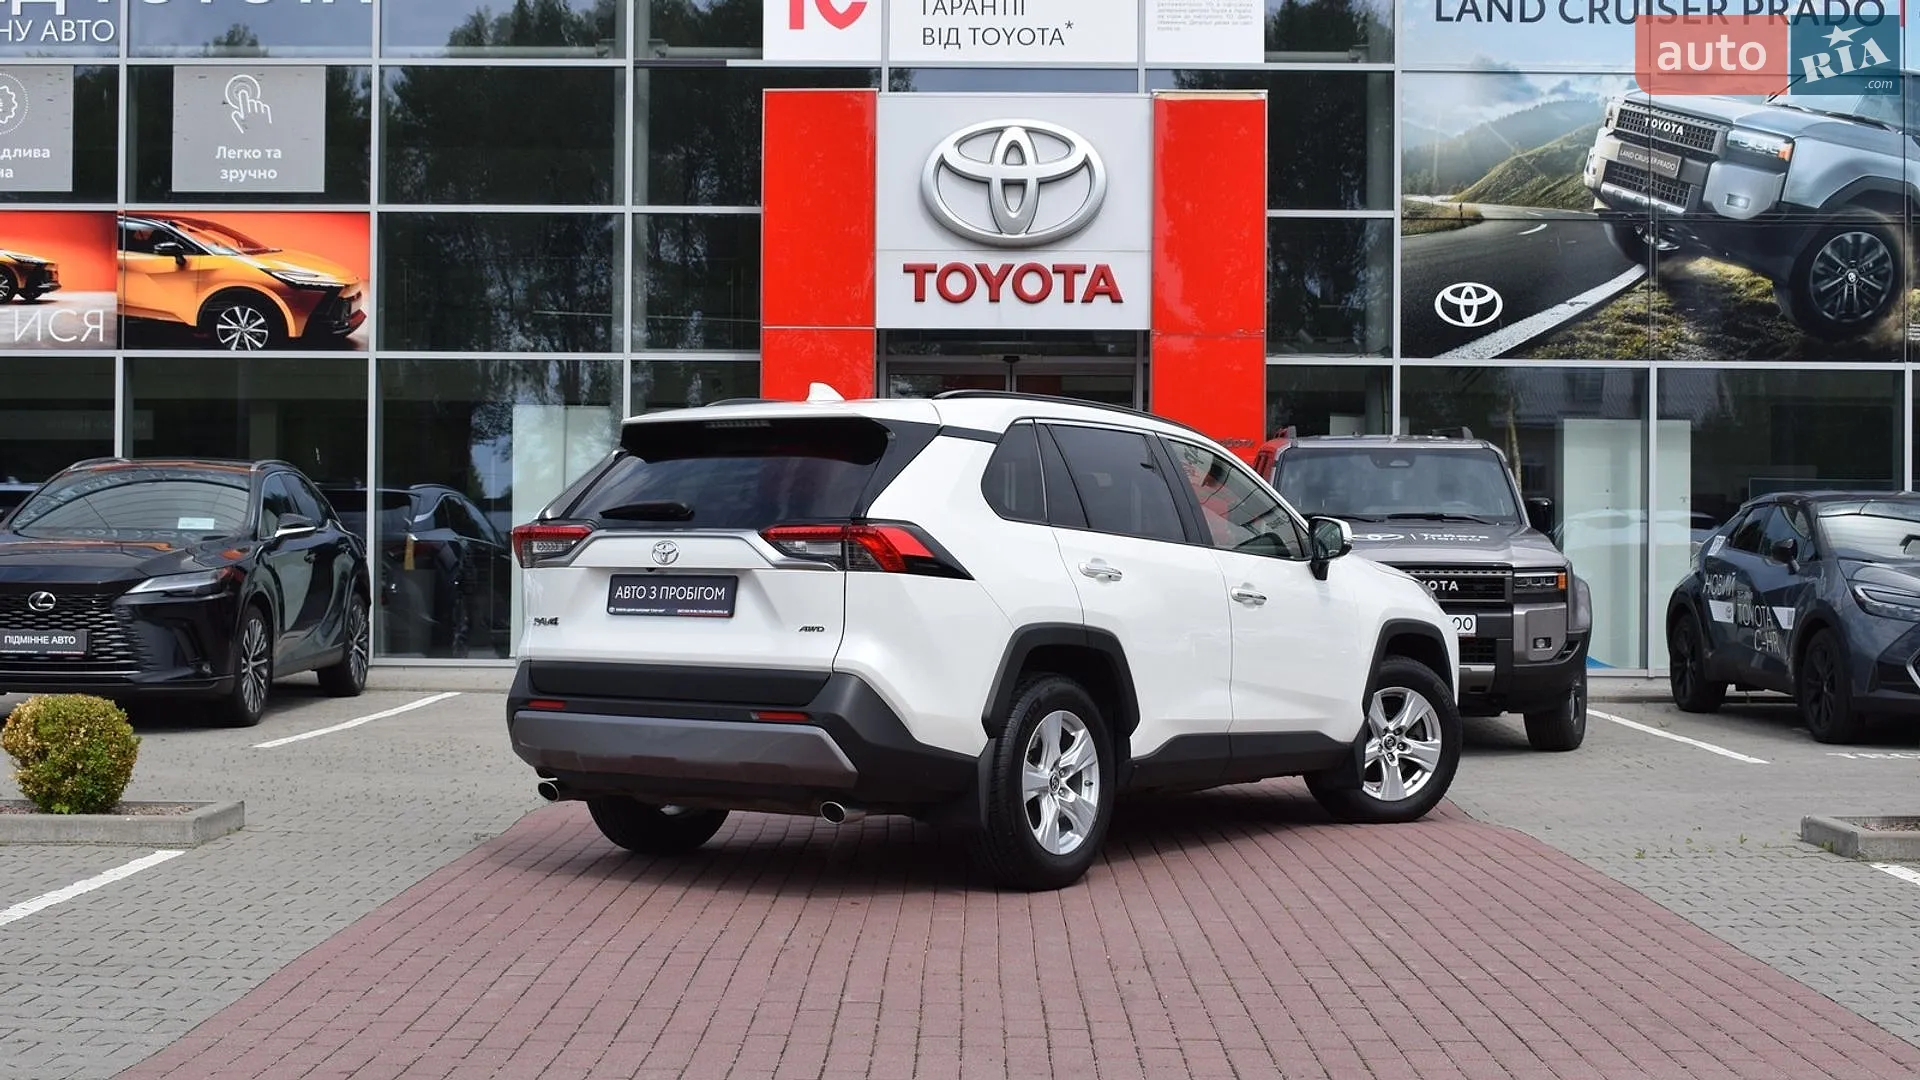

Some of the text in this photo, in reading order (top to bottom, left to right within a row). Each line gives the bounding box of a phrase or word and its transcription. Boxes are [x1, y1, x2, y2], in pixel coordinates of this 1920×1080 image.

[1435, 0, 1545, 23] LAND
[1558, 0, 1726, 26] CRUISER
[1743, 0, 1886, 27] PRADO
[40, 19, 115, 42] АВТО
[922, 27, 961, 50] ВІД
[1645, 118, 1684, 136] TOYOTA
[215, 146, 282, 162] Легко та
[220, 168, 278, 183] зручно
[902, 262, 1124, 303] TOYOTA
[615, 585, 647, 600] АВТО
[659, 585, 726, 601] ПРОБІГОМ
[1703, 571, 1736, 597] НОВИЙ
[1737, 603, 1773, 630] TOYOTA
[4, 635, 77, 646] ПІДМІННЕ АВТО
[1754, 629, 1781, 655] C-HR
